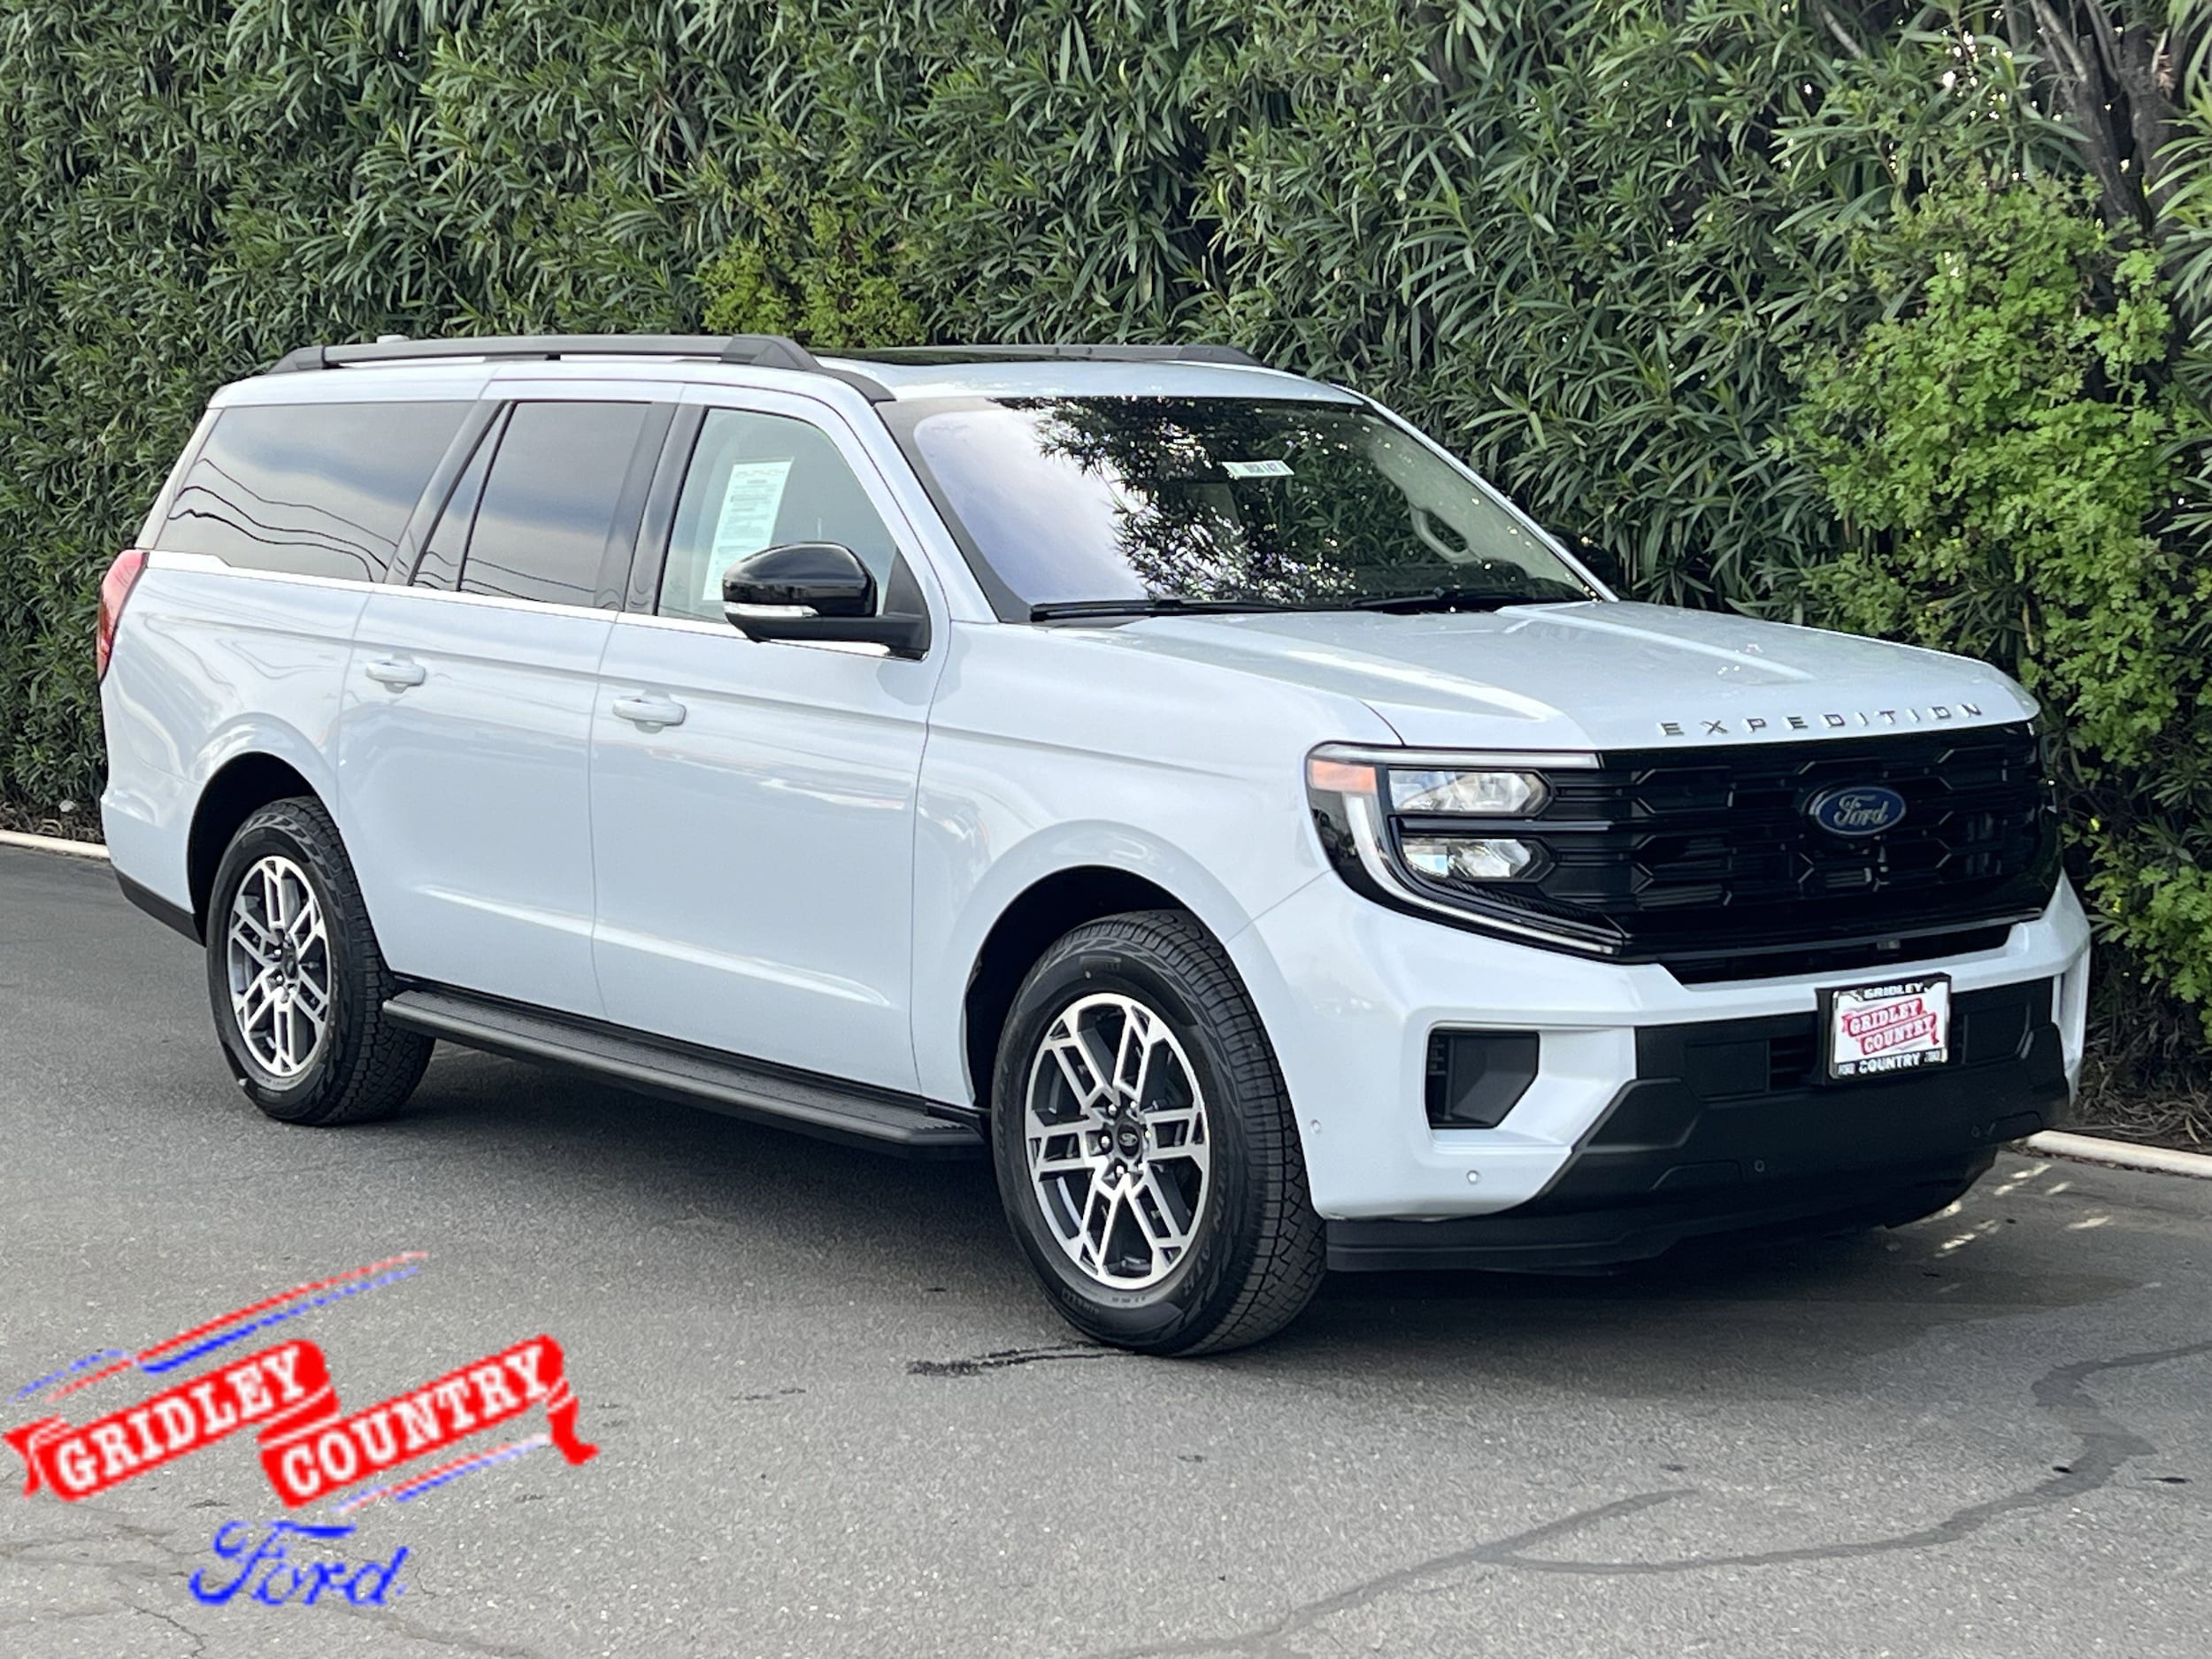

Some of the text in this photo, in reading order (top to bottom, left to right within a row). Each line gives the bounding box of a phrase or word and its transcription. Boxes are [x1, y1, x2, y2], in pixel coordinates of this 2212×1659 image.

[1658, 703, 1982, 735] EXPEDITION
[1832, 795, 1888, 828] Ford
[1864, 983, 1924, 998] GRIDLEY
[1850, 1001, 1918, 1034] GRIDLEY
[1864, 1017, 1933, 1052] COUNTRY
[1859, 1053, 1921, 1073] COUNTRY
